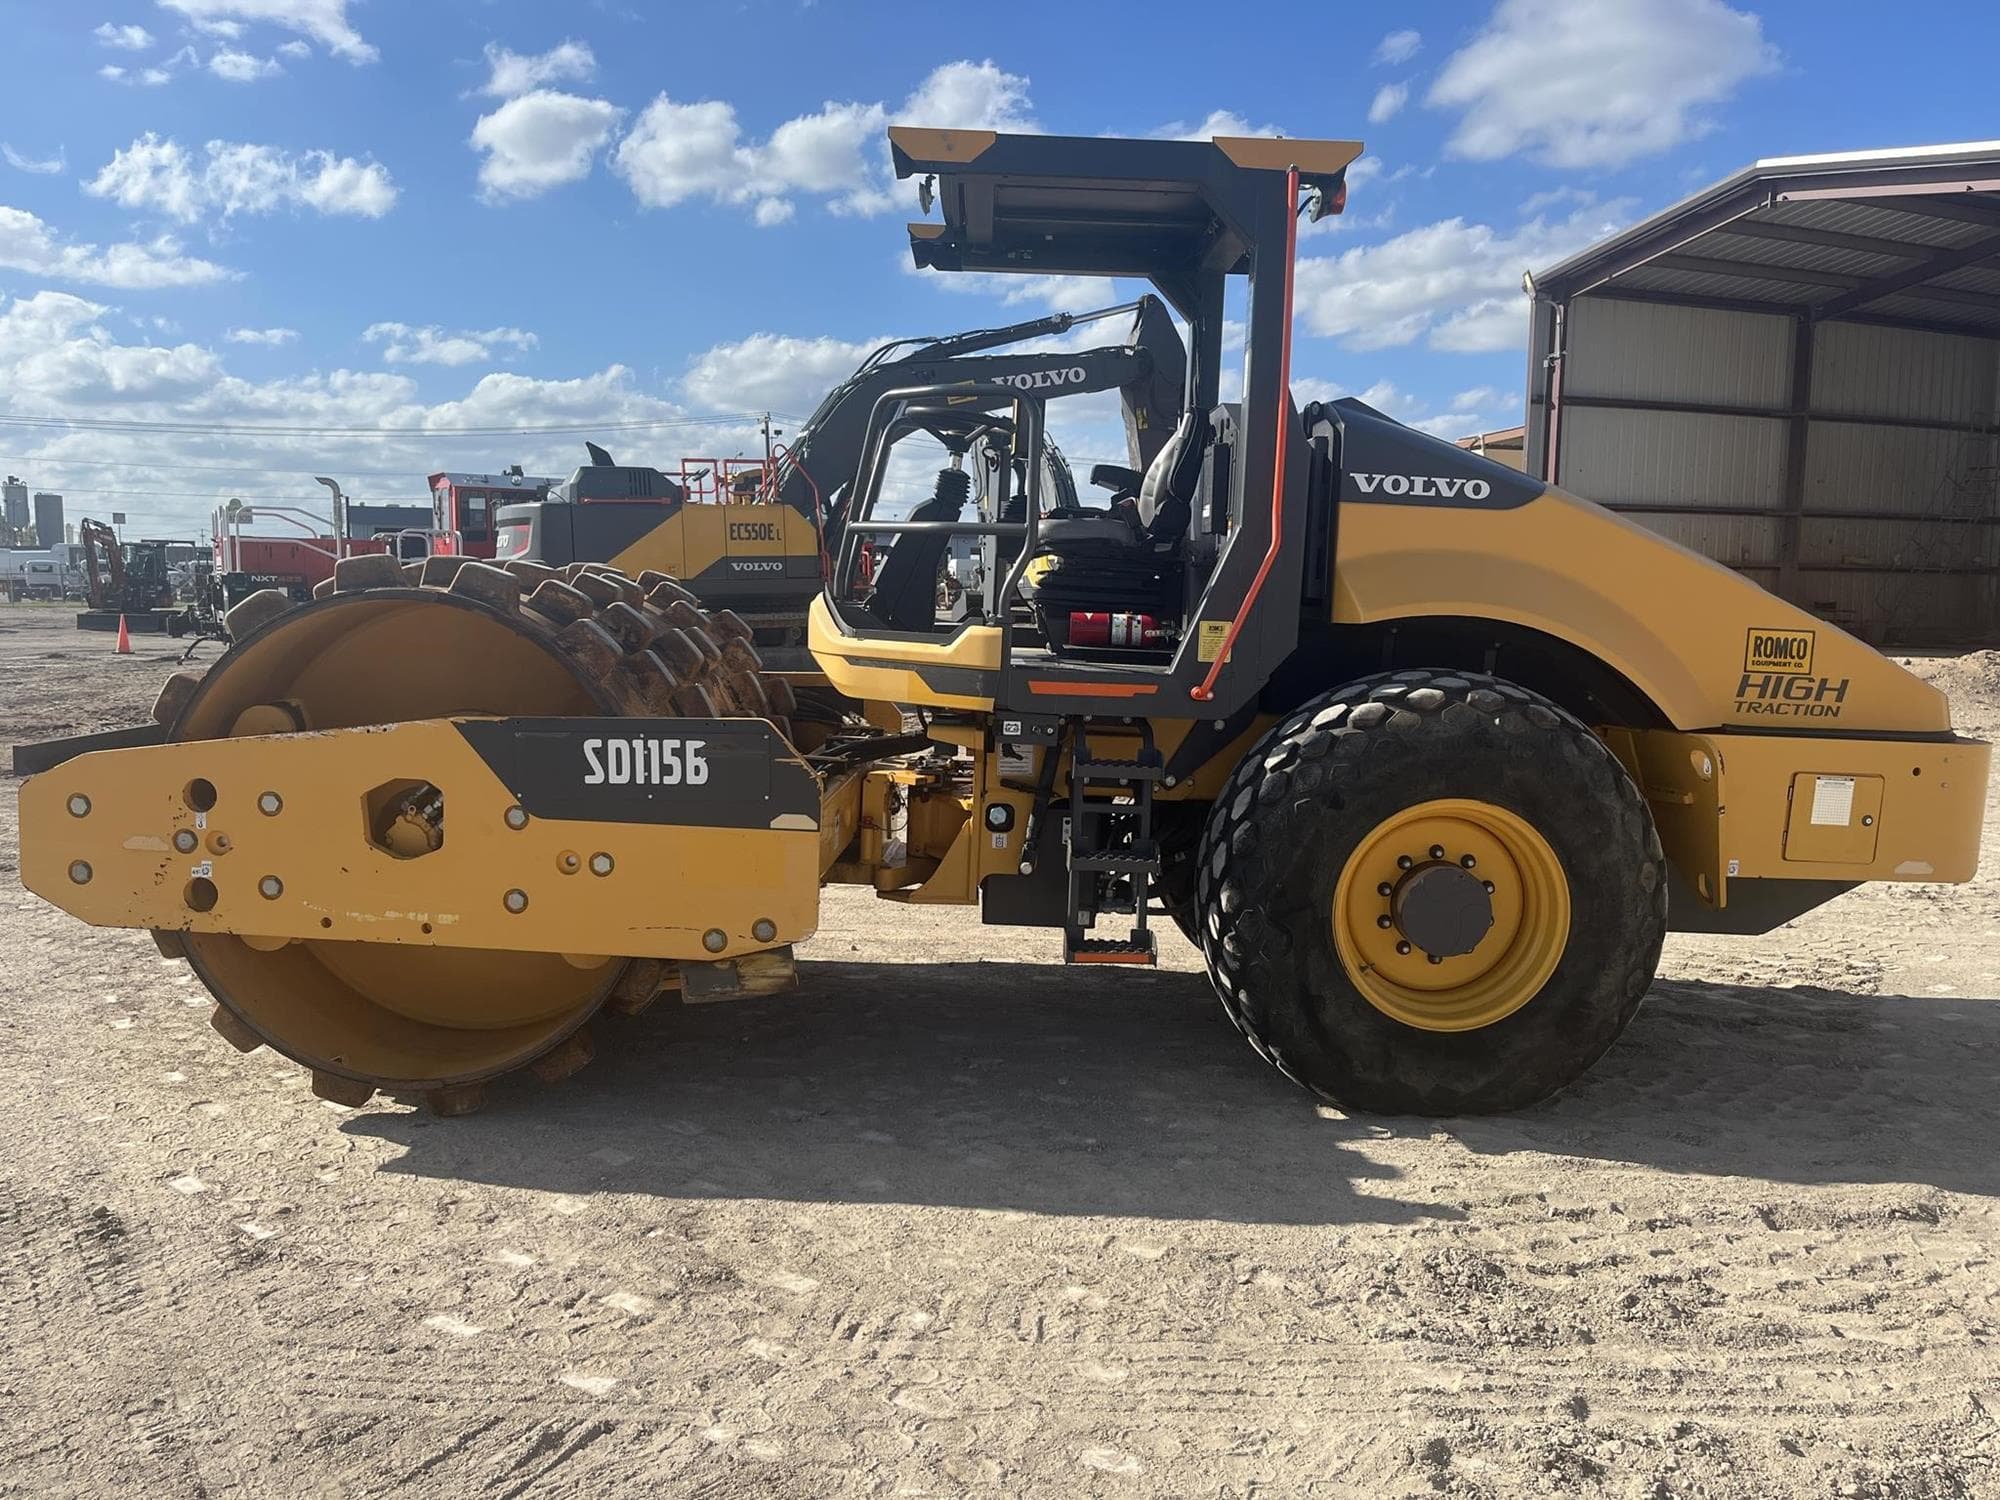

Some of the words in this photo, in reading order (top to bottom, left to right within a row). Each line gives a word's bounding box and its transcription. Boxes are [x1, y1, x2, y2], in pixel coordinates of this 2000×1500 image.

[991, 367, 1087, 390] VOLVO
[1349, 472, 1491, 500] VOLVO
[730, 562, 783, 572] VOLVO
[251, 575, 278, 583] NXT
[1752, 635, 1808, 660] ROMCO
[1751, 660, 1792, 668] EQUIPMENT
[1735, 674, 1850, 703] HIGH
[1733, 701, 1841, 718] TRACTION
